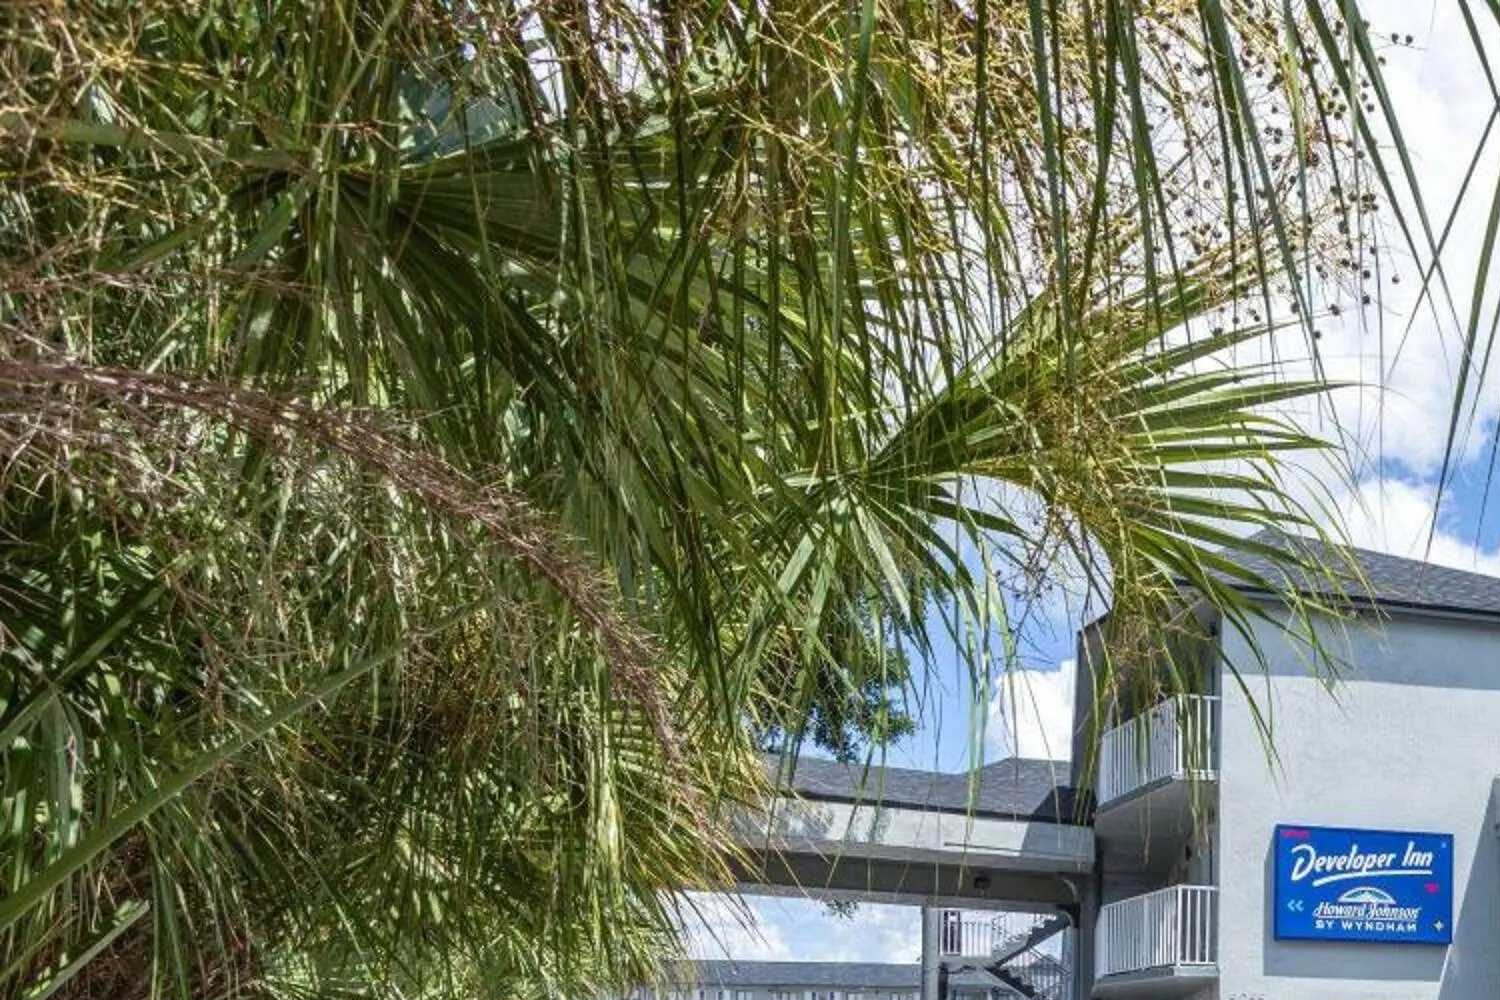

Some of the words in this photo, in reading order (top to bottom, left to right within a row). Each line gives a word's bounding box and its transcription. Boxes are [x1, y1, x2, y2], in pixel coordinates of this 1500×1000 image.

[1291, 843, 1396, 881] Developer
[1402, 841, 1433, 867] Inn
[1312, 901, 1366, 918] Howard
[1367, 902, 1421, 920] Johnson
[1314, 919, 1335, 930] BY
[1340, 919, 1417, 932] WYNDHAM
